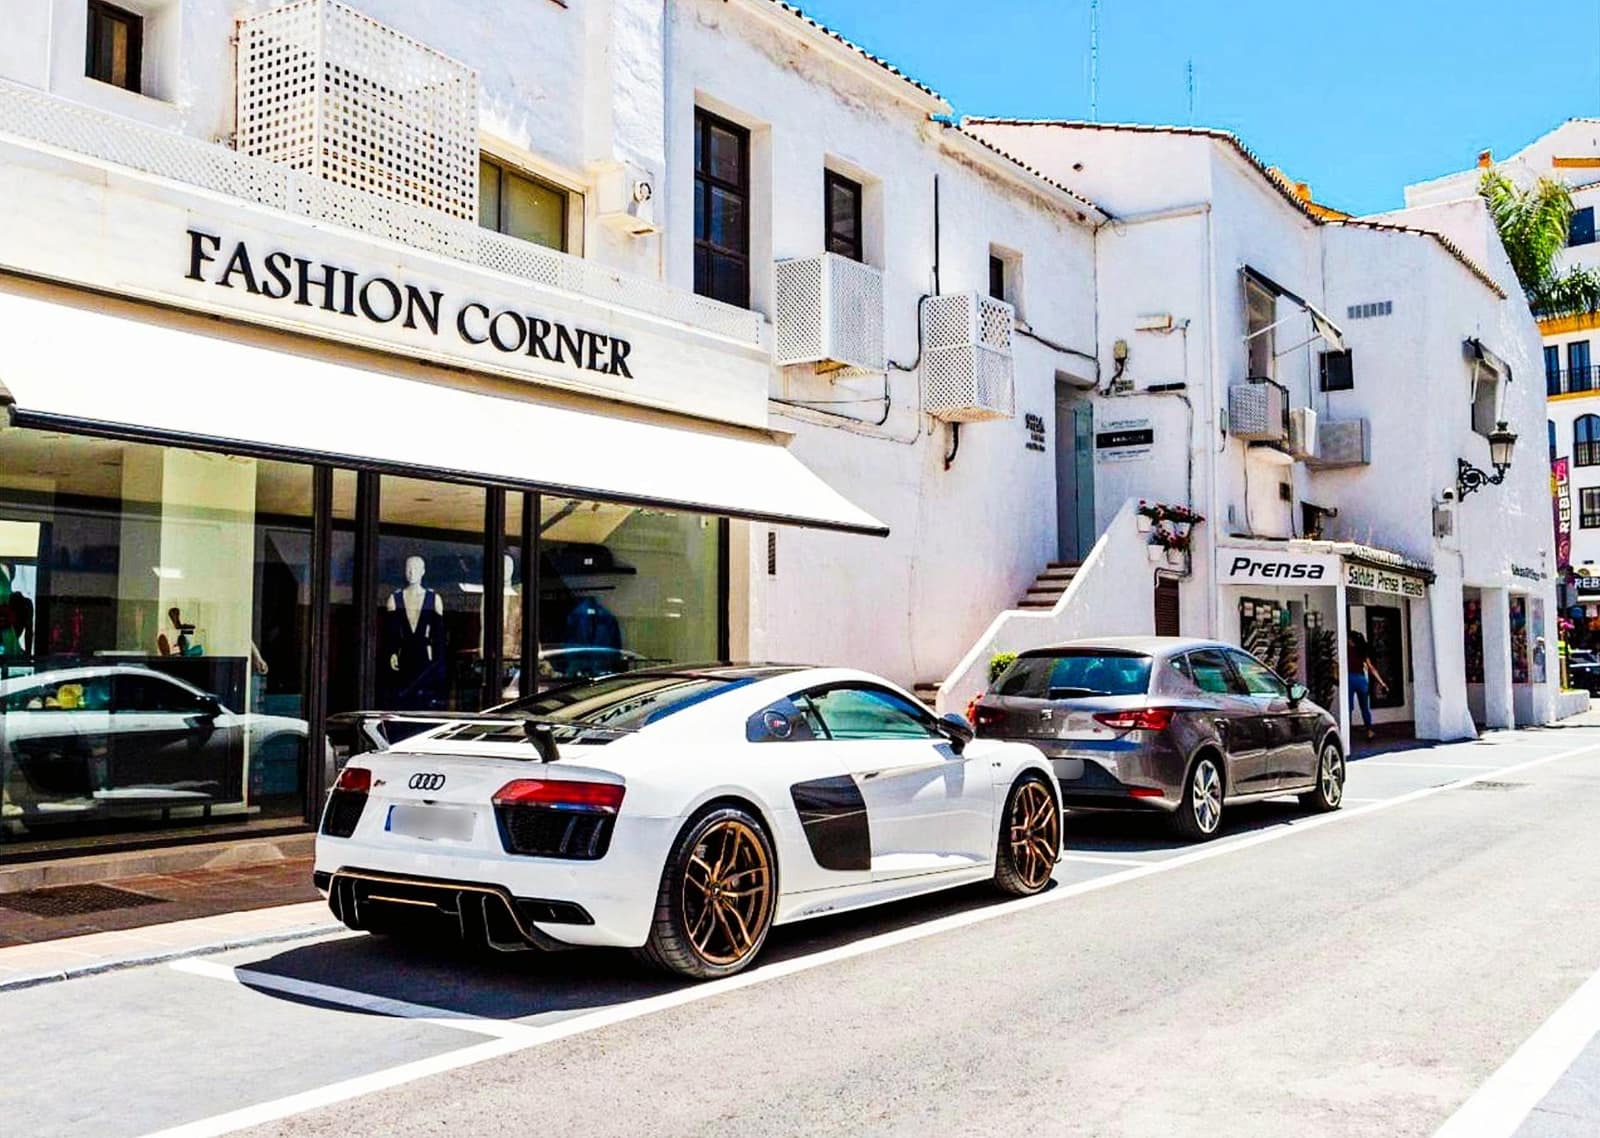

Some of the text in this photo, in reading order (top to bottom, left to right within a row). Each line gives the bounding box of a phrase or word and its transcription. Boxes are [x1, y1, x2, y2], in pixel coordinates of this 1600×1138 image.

[184, 229, 634, 379] FASHION CORNER
[1230, 557, 1325, 579] Prensa
[1376, 571, 1399, 592] Prensa
